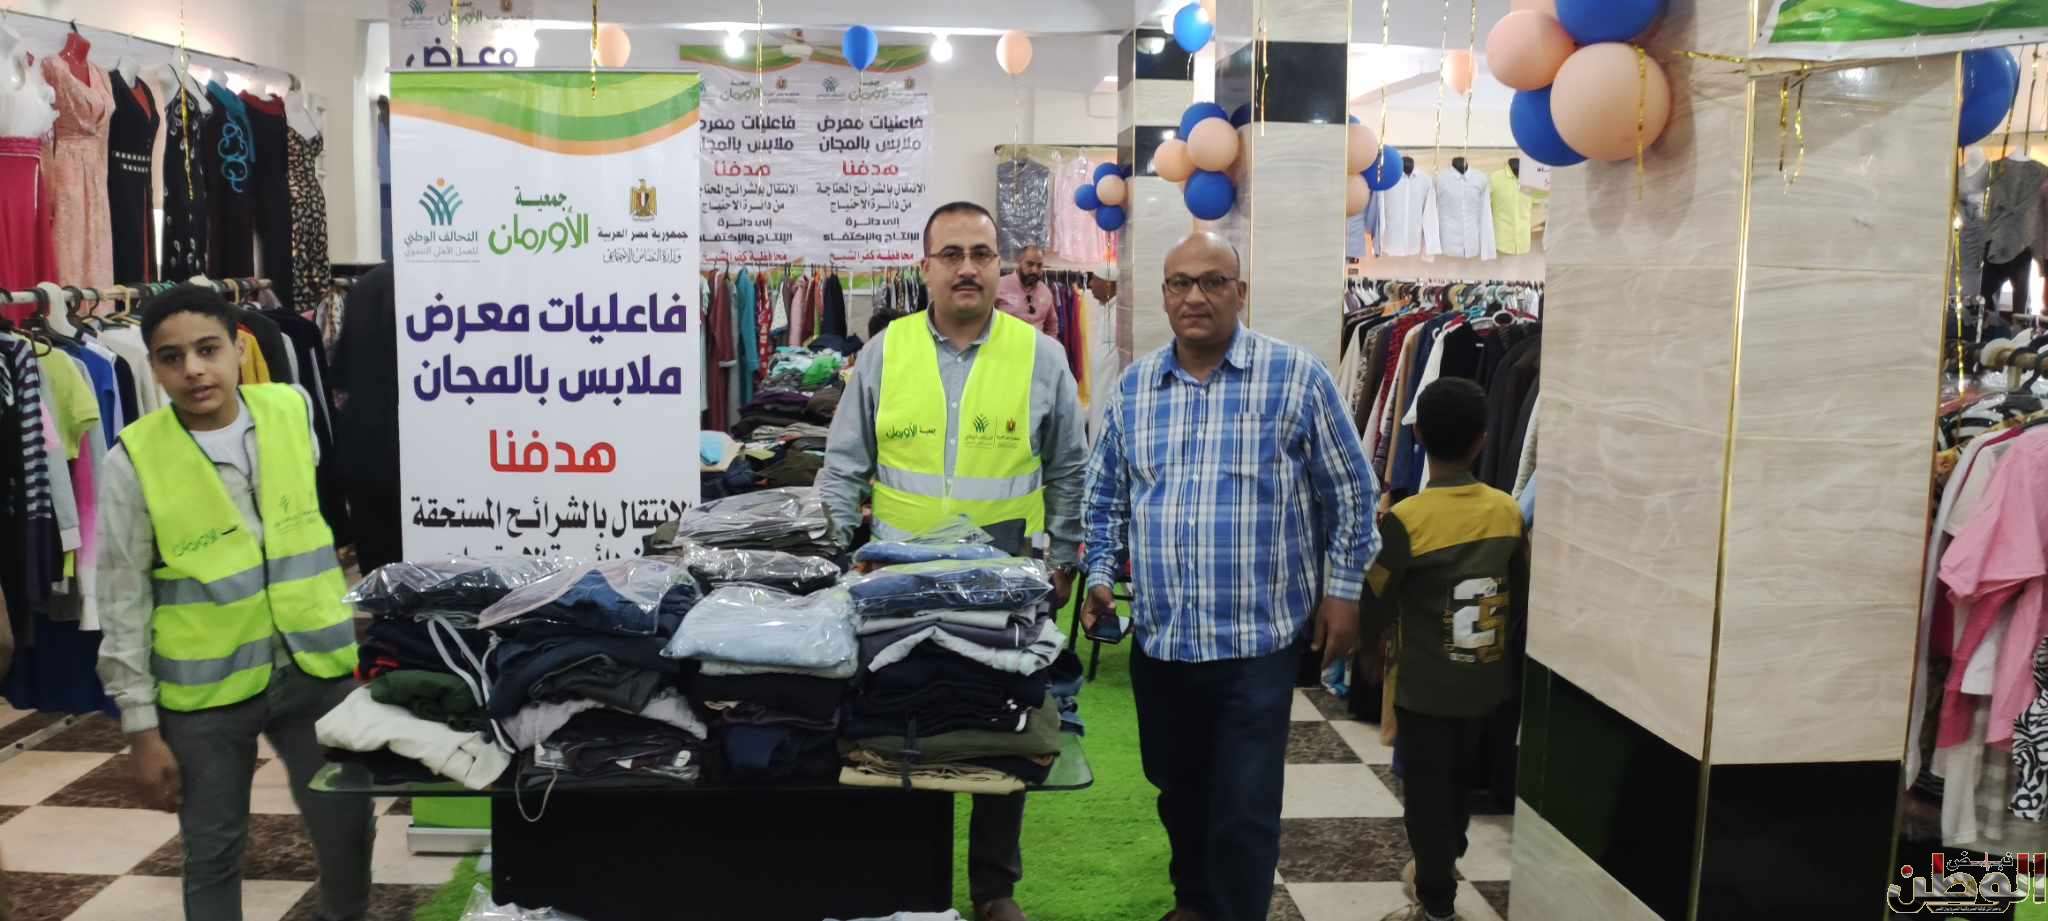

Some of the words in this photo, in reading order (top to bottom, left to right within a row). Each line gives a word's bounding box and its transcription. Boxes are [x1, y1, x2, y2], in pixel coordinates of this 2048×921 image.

[741, 115, 796, 133] فاعليات
[817, 115, 864, 133] معرض
[870, 115, 923, 132] فاعليات
[701, 136, 741, 154] بالمجا
[747, 136, 794, 154] ملابس
[819, 136, 870, 154] بالمجان
[876, 136, 921, 153] ملابس
[714, 160, 771, 177] هدفنا
[843, 160, 899, 176] هدفنا
[515, 185, 567, 212] جمعية
[404, 228, 436, 247] الوطني
[439, 228, 478, 243] التحالف
[488, 203, 589, 256] الأورمان
[597, 226, 628, 243] العربية
[631, 231, 649, 242] مصر
[652, 227, 688, 243] جمهورية
[405, 292, 530, 344] معرض
[538, 292, 687, 344] فاعليات
[413, 353, 549, 406] بالمجان
[558, 353, 682, 406] ملابس
[488, 429, 617, 473] هدفنا
[411, 495, 500, 531] المستحقة
[506, 495, 607, 538] بالشرائح
[612, 498, 692, 538] لانتقال
